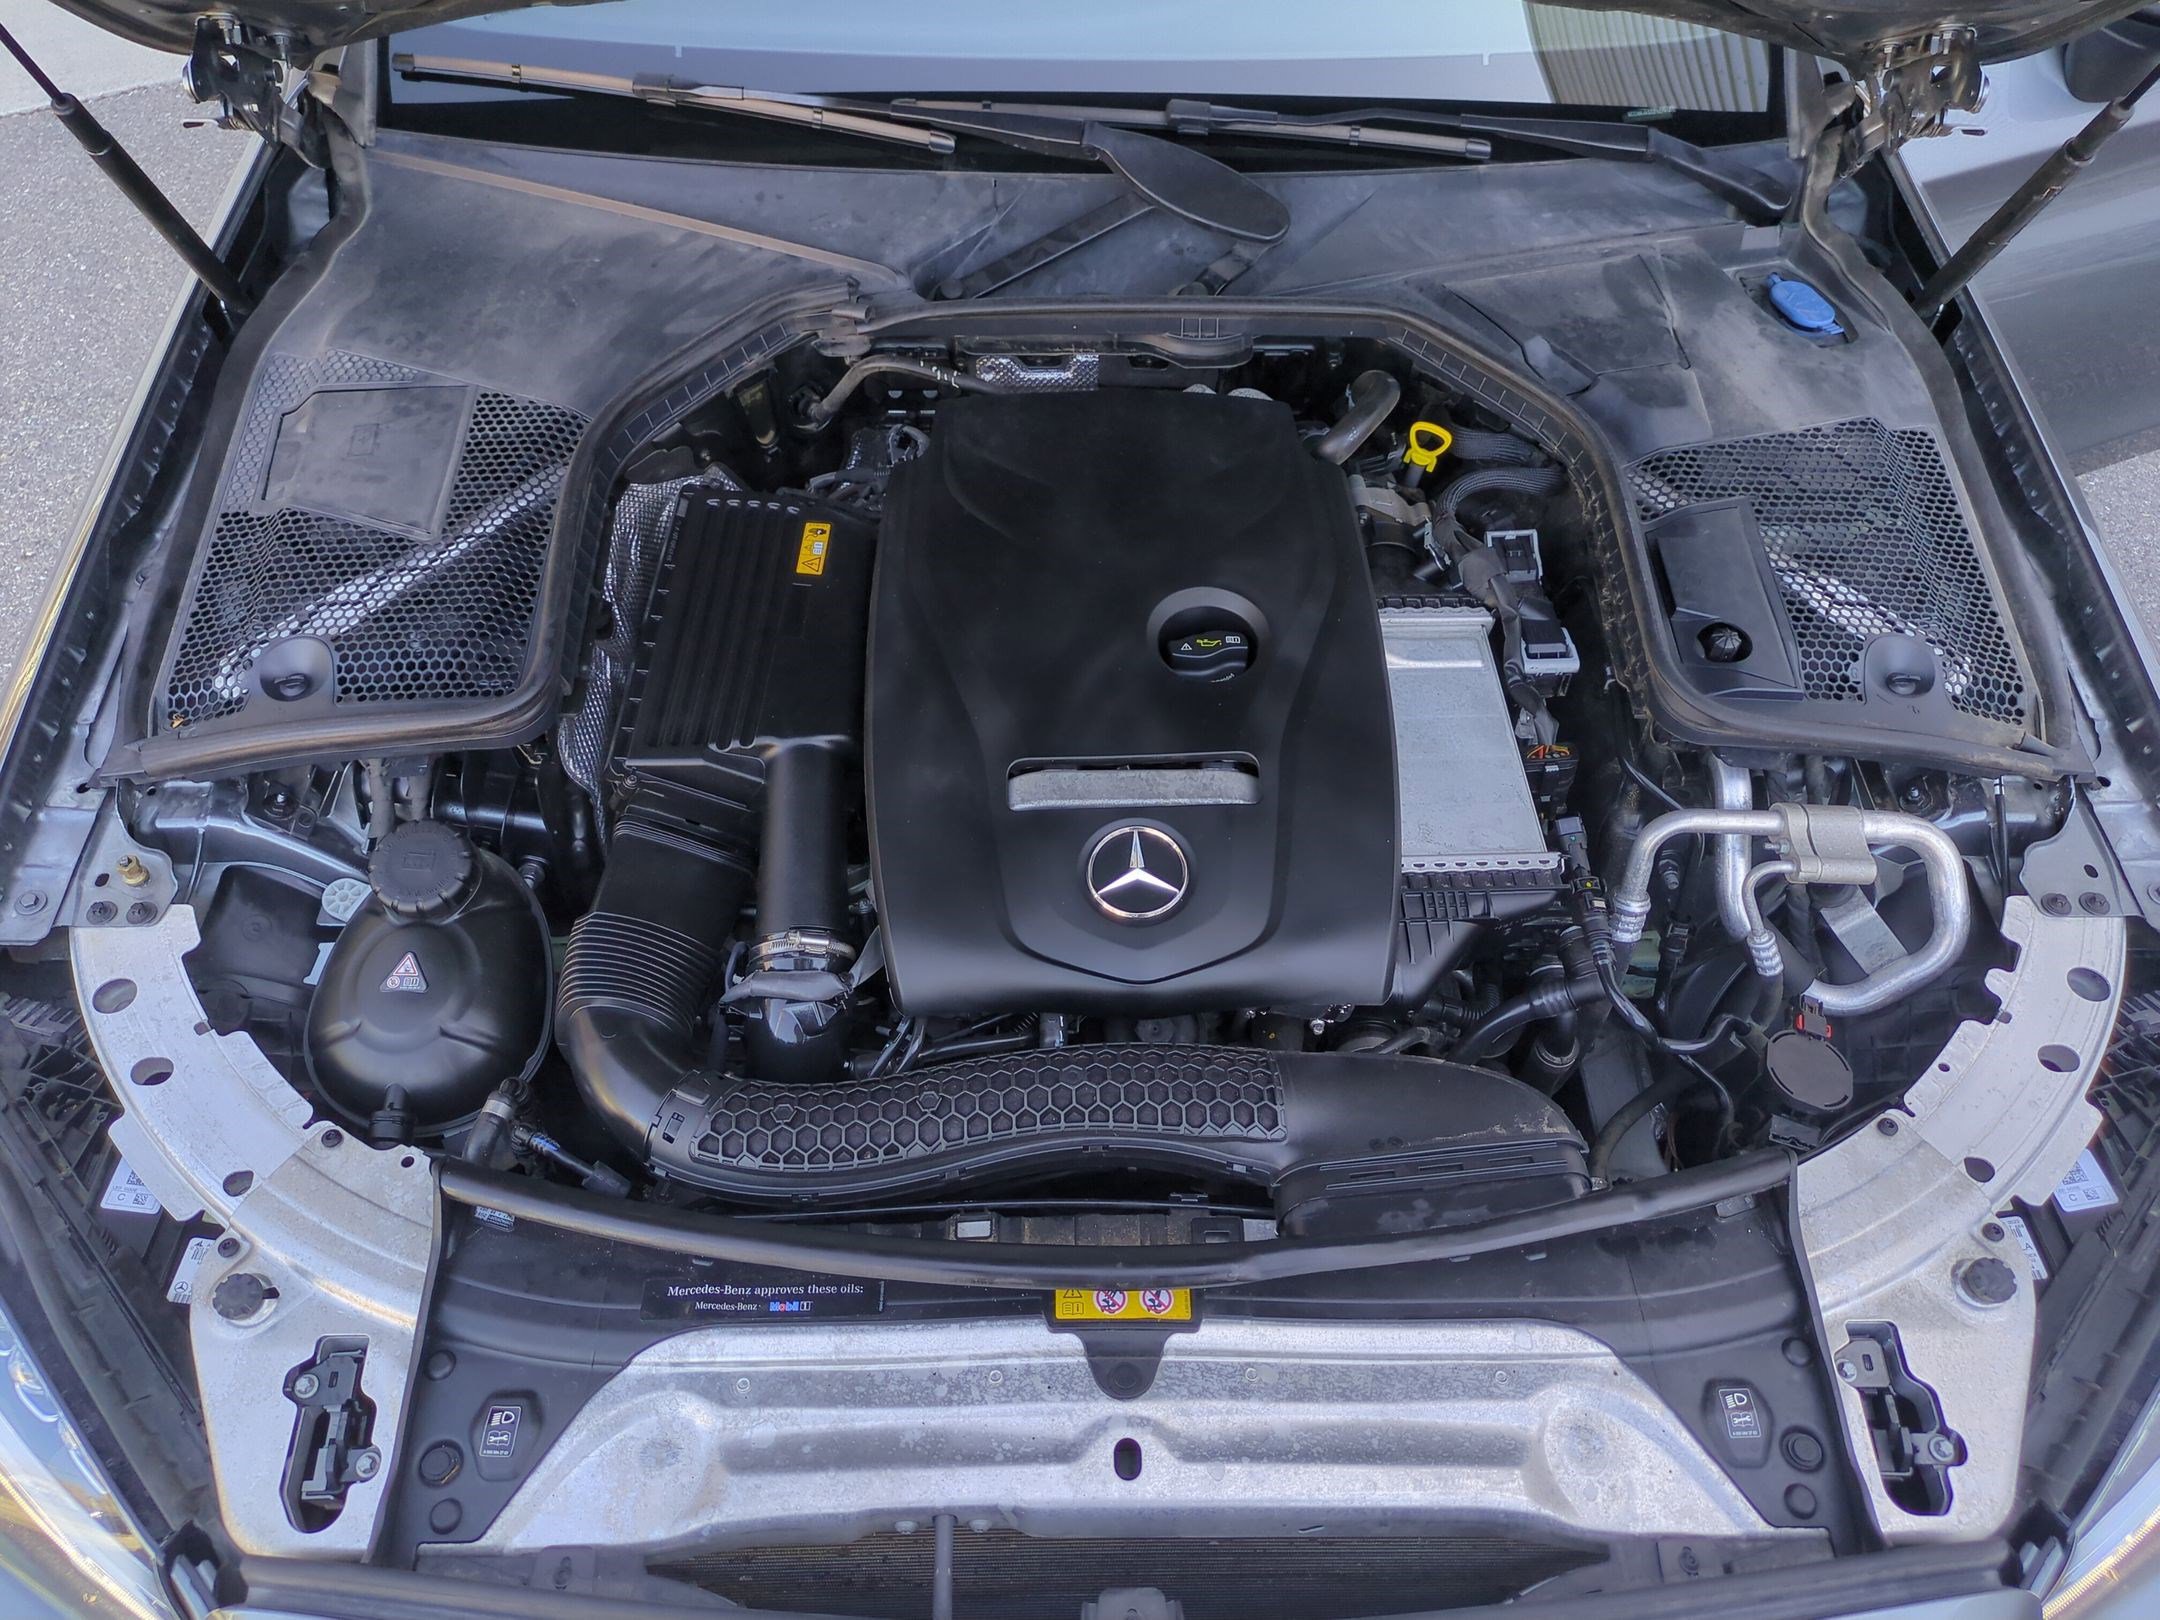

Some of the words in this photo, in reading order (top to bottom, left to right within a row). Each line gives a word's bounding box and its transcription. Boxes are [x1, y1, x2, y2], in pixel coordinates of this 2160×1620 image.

[667, 1284, 751, 1297] Mercedes-Benz
[754, 1285, 805, 1297] approves
[807, 1284, 838, 1294] these
[840, 1283, 864, 1294] oils:
[769, 1301, 799, 1311] Mobil
